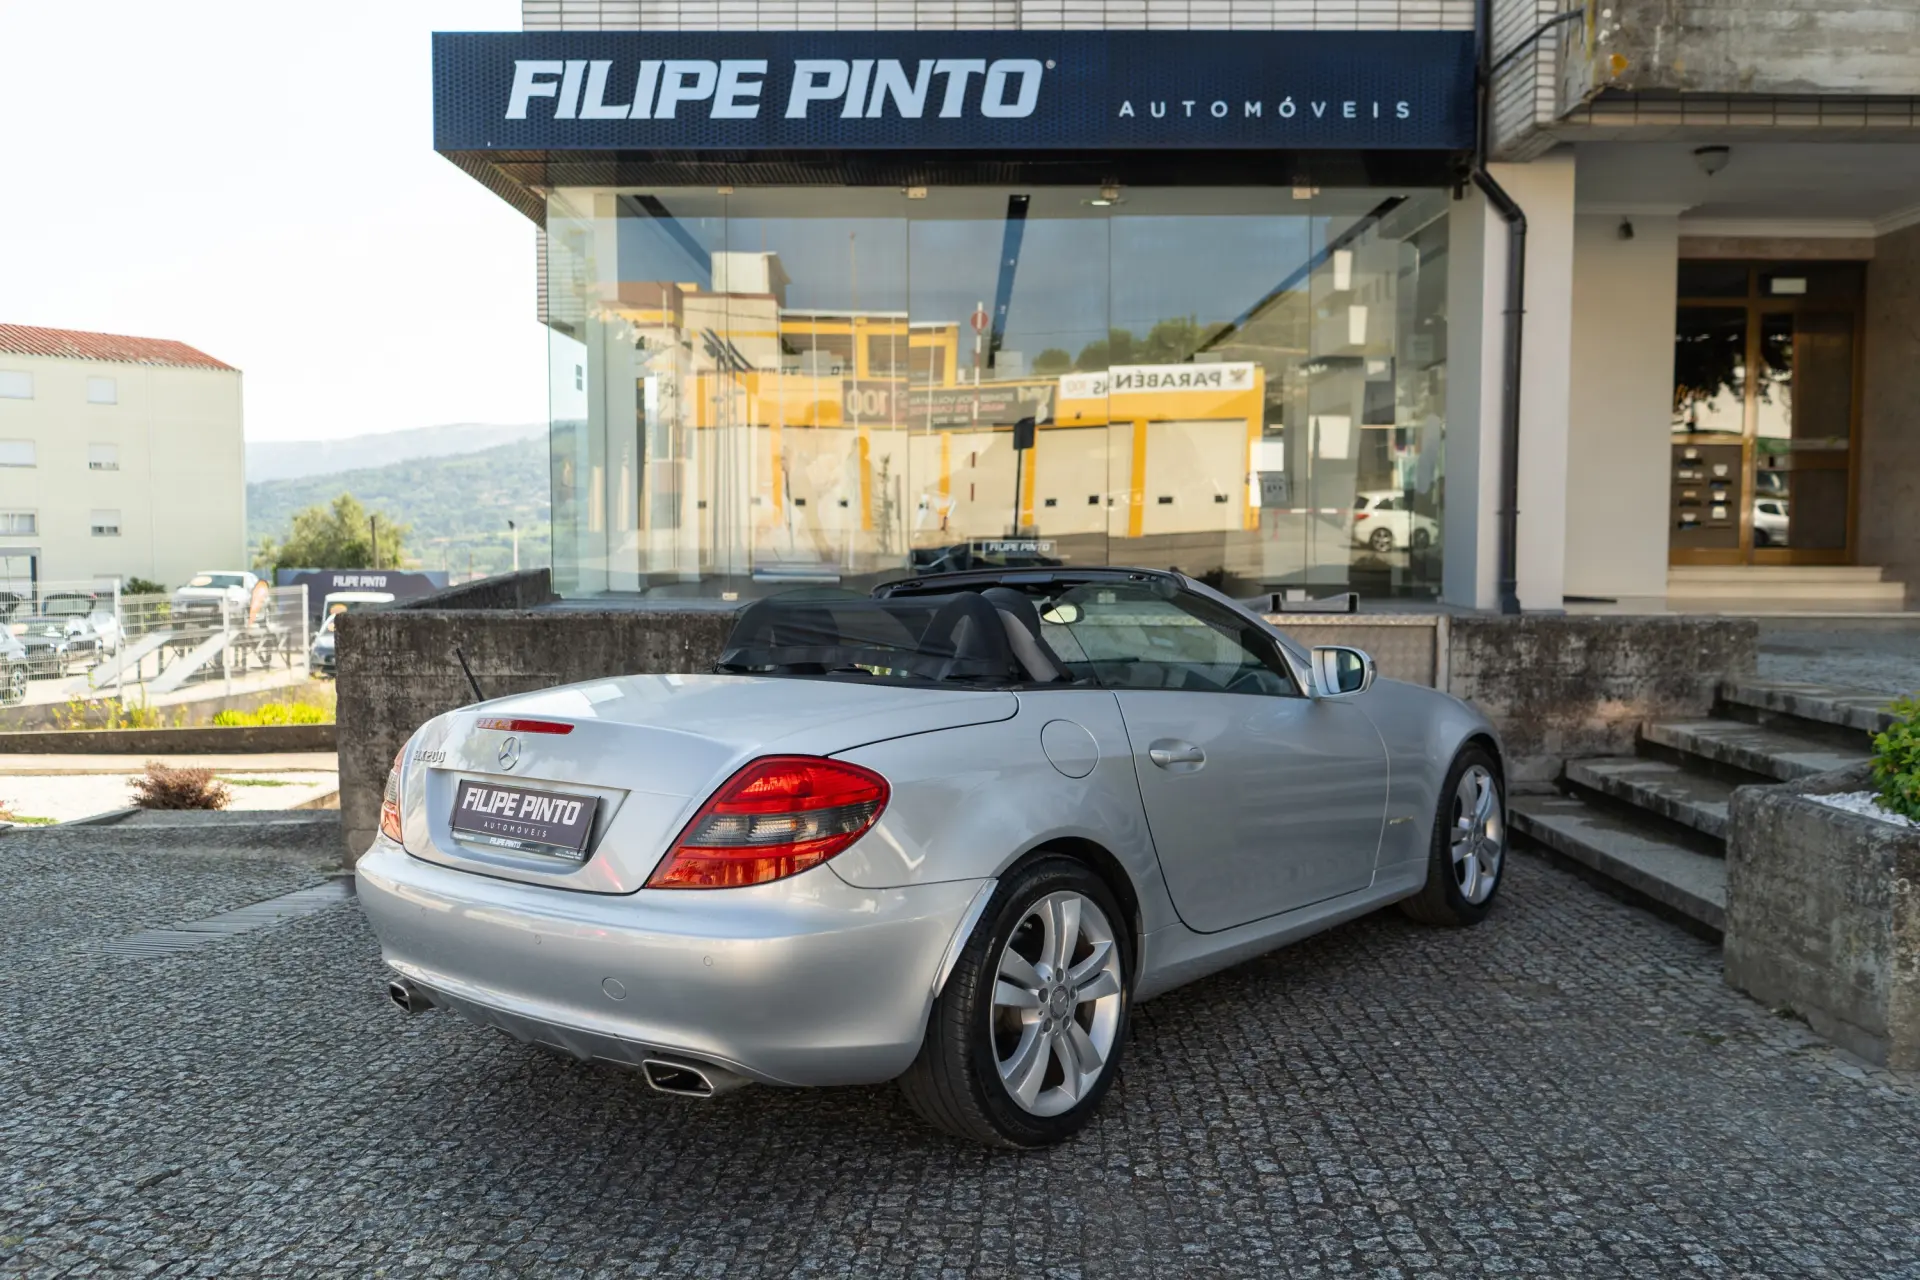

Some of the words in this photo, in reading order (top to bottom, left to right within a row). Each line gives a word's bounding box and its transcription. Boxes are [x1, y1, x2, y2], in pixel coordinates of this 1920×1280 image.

[505, 58, 767, 120] FILIPE
[785, 58, 1044, 119] PINTO
[1119, 96, 1411, 118] AUTOMÓVEIS
[333, 575, 359, 587] FILIPE
[360, 576, 387, 587] PINTO
[462, 787, 520, 817] FILIPE
[518, 795, 581, 826] PINTO
[484, 821, 547, 838] AUTOMÓVEIS
